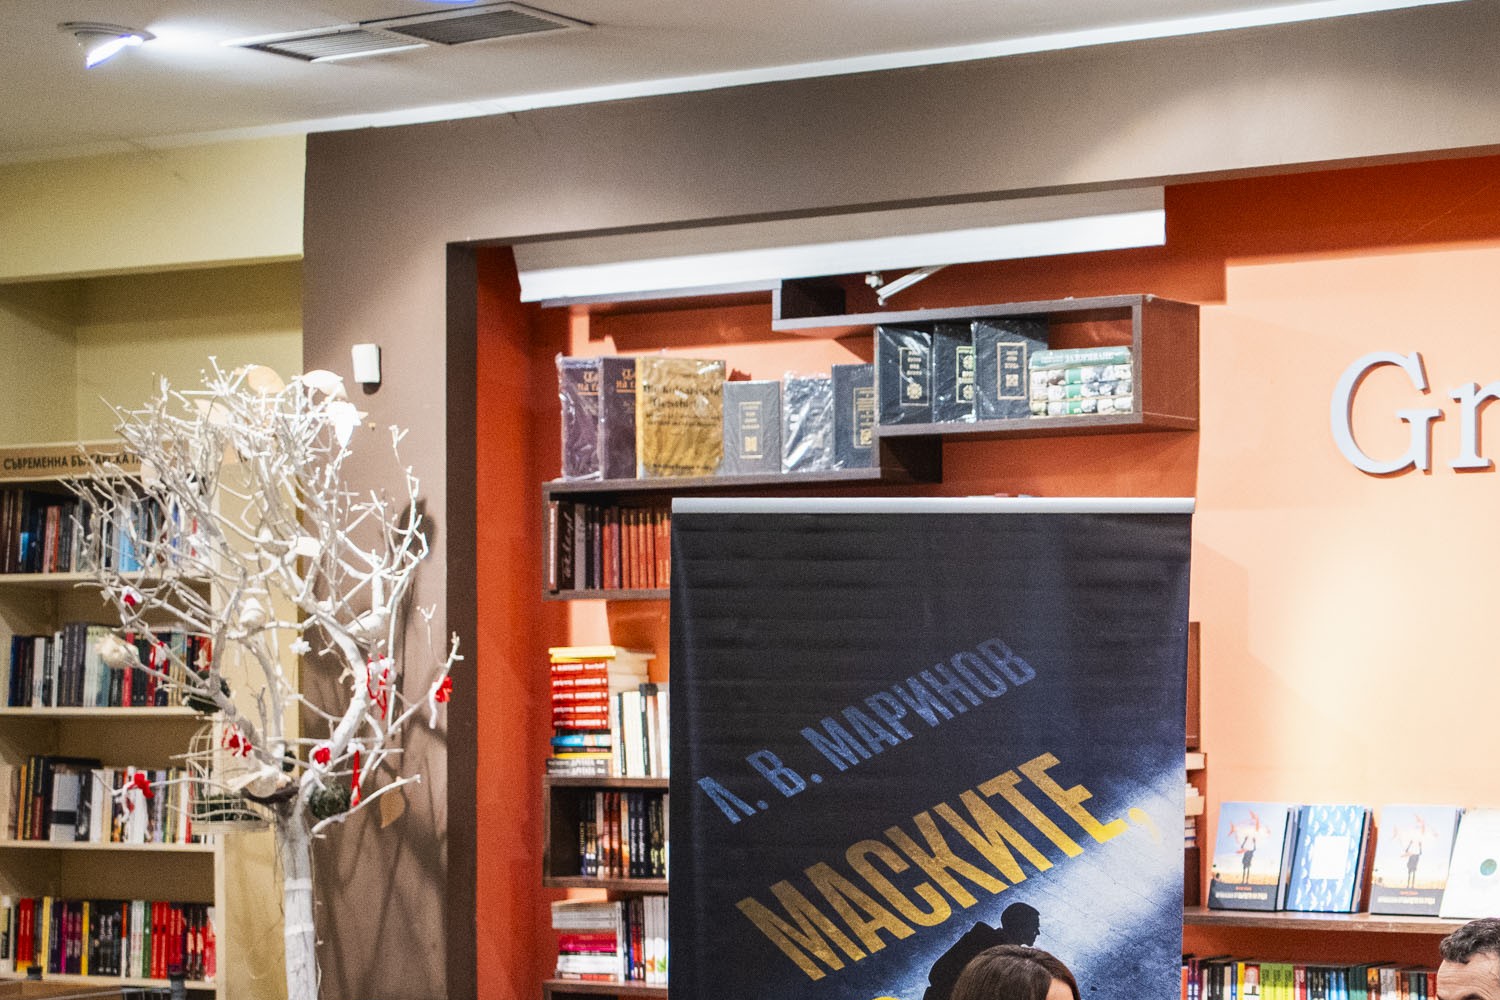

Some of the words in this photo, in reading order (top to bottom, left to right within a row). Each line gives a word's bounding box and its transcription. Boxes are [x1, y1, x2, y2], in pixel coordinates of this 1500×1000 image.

[3, 456, 68, 471] СЪВРЕМЕННА
[71, 453, 129, 468] БЪГАРСКА
[745, 748, 822, 798] В.
[800, 637, 1037, 772] МАРИНОВ
[736, 752, 1162, 982] МАСКИТЕ,
